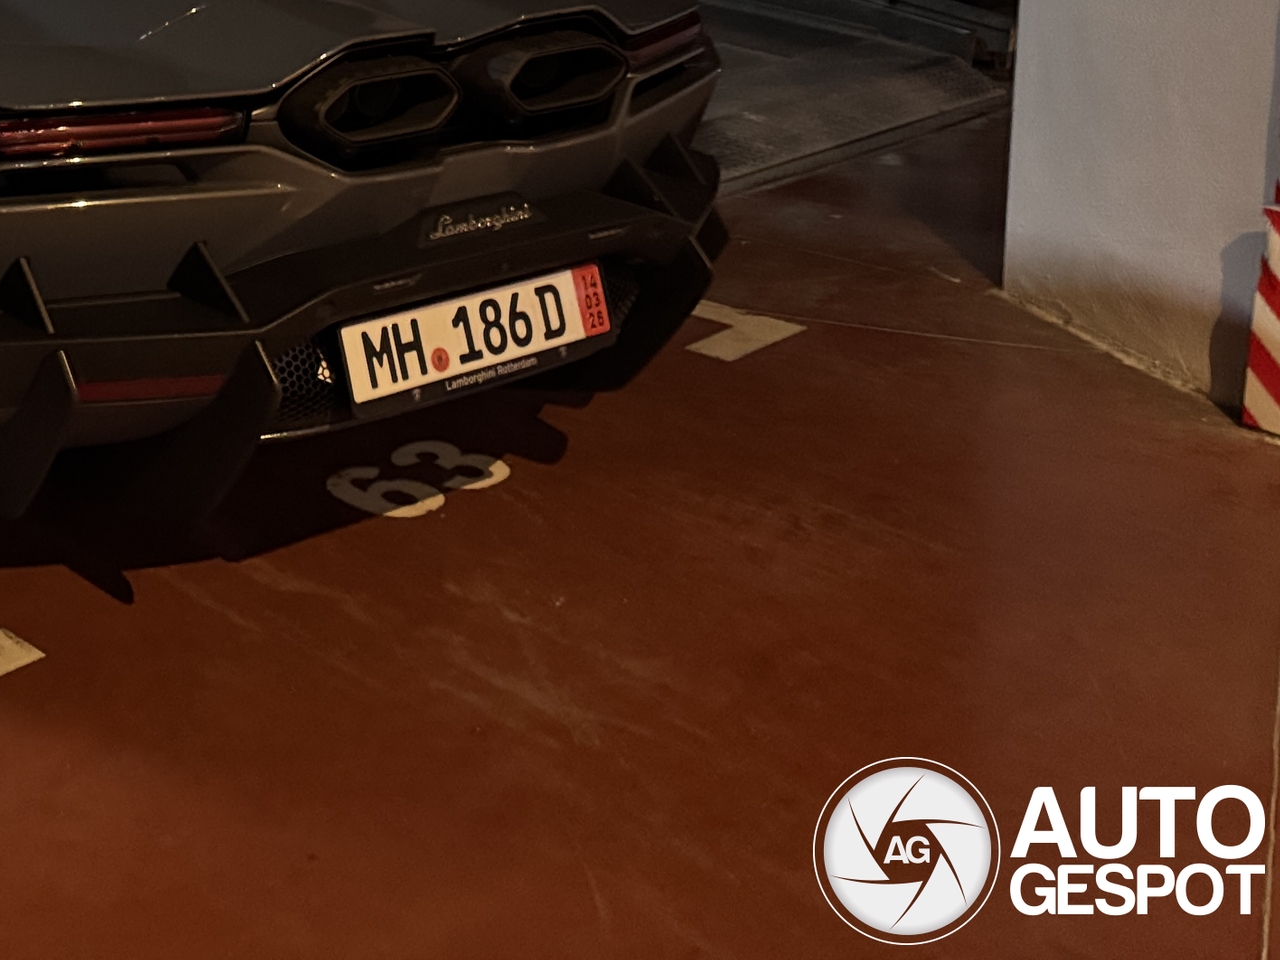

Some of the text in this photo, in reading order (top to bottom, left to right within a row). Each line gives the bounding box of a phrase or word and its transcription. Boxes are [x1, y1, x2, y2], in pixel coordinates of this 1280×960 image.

[429, 202, 533, 239] Lamborghini
[361, 284, 566, 389] MH 186 D
[445, 356, 538, 391] Lamborghini Rotterdam
[326, 440, 511, 518] 63
